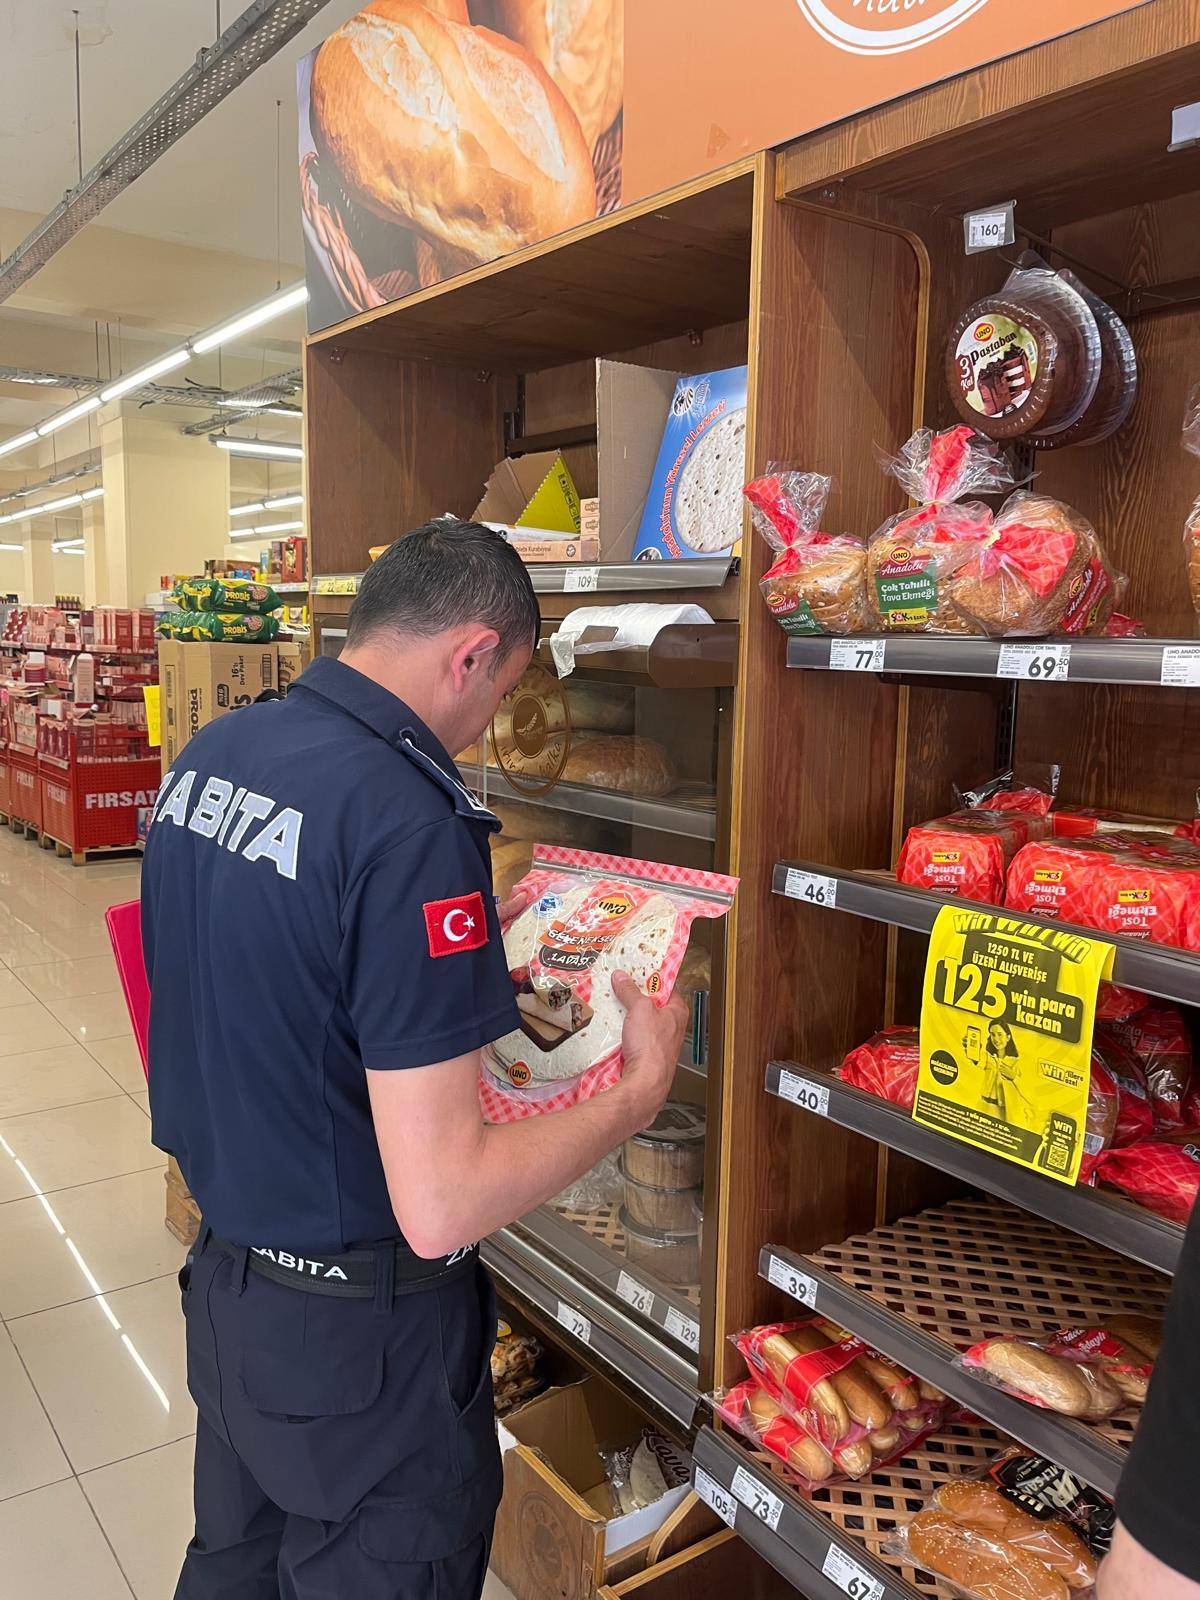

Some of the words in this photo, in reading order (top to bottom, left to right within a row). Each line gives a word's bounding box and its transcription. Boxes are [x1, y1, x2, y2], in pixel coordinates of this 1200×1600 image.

[981, 224, 998, 236] 160
[975, 326, 991, 339] UNO
[970, 332, 1017, 366] Pastaban
[960, 357, 971, 378] 3
[893, 552, 908, 560] UNO
[881, 560, 923, 575] Anadolu
[577, 576, 592, 588] 109
[881, 583, 898, 594] Çok
[899, 579, 930, 591] Tahıllı
[881, 594, 901, 602] Tava
[902, 588, 935, 600] Ekmeği
[855, 650, 874, 669] 77
[1028, 656, 1057, 678] 69
[923, 864, 966, 877] Ekmeği
[934, 875, 957, 884] Tost
[804, 883, 825, 903] 46
[1024, 882, 1067, 897] Ekmeği
[1034, 894, 1058, 904] Tost
[598, 901, 627, 915] UNO
[1108, 904, 1158, 920] Ekmeği
[1121, 917, 1148, 927] Tost
[987, 942, 1009, 957] 1250
[1011, 948, 1021, 961] TL
[1022, 951, 1035, 964] VE
[972, 950, 998, 969] ÜZERİ
[998, 961, 1048, 984] ALIŞVERİŞE
[650, 976, 658, 993] UNO
[943, 957, 1010, 1019] 125
[1011, 989, 1036, 1009] win
[1039, 996, 1076, 1019] para
[1016, 1005, 1062, 1034] kazan
[511, 1068, 527, 1080] UNO
[797, 1088, 818, 1110] 40
[250, 1246, 348, 1280] ABITA
[788, 1276, 808, 1299] 39
[631, 1290, 646, 1311] 76
[572, 1318, 584, 1338] 72
[680, 1325, 697, 1344] 129
[711, 1489, 729, 1515] 105
[752, 1492, 771, 1521] 73
